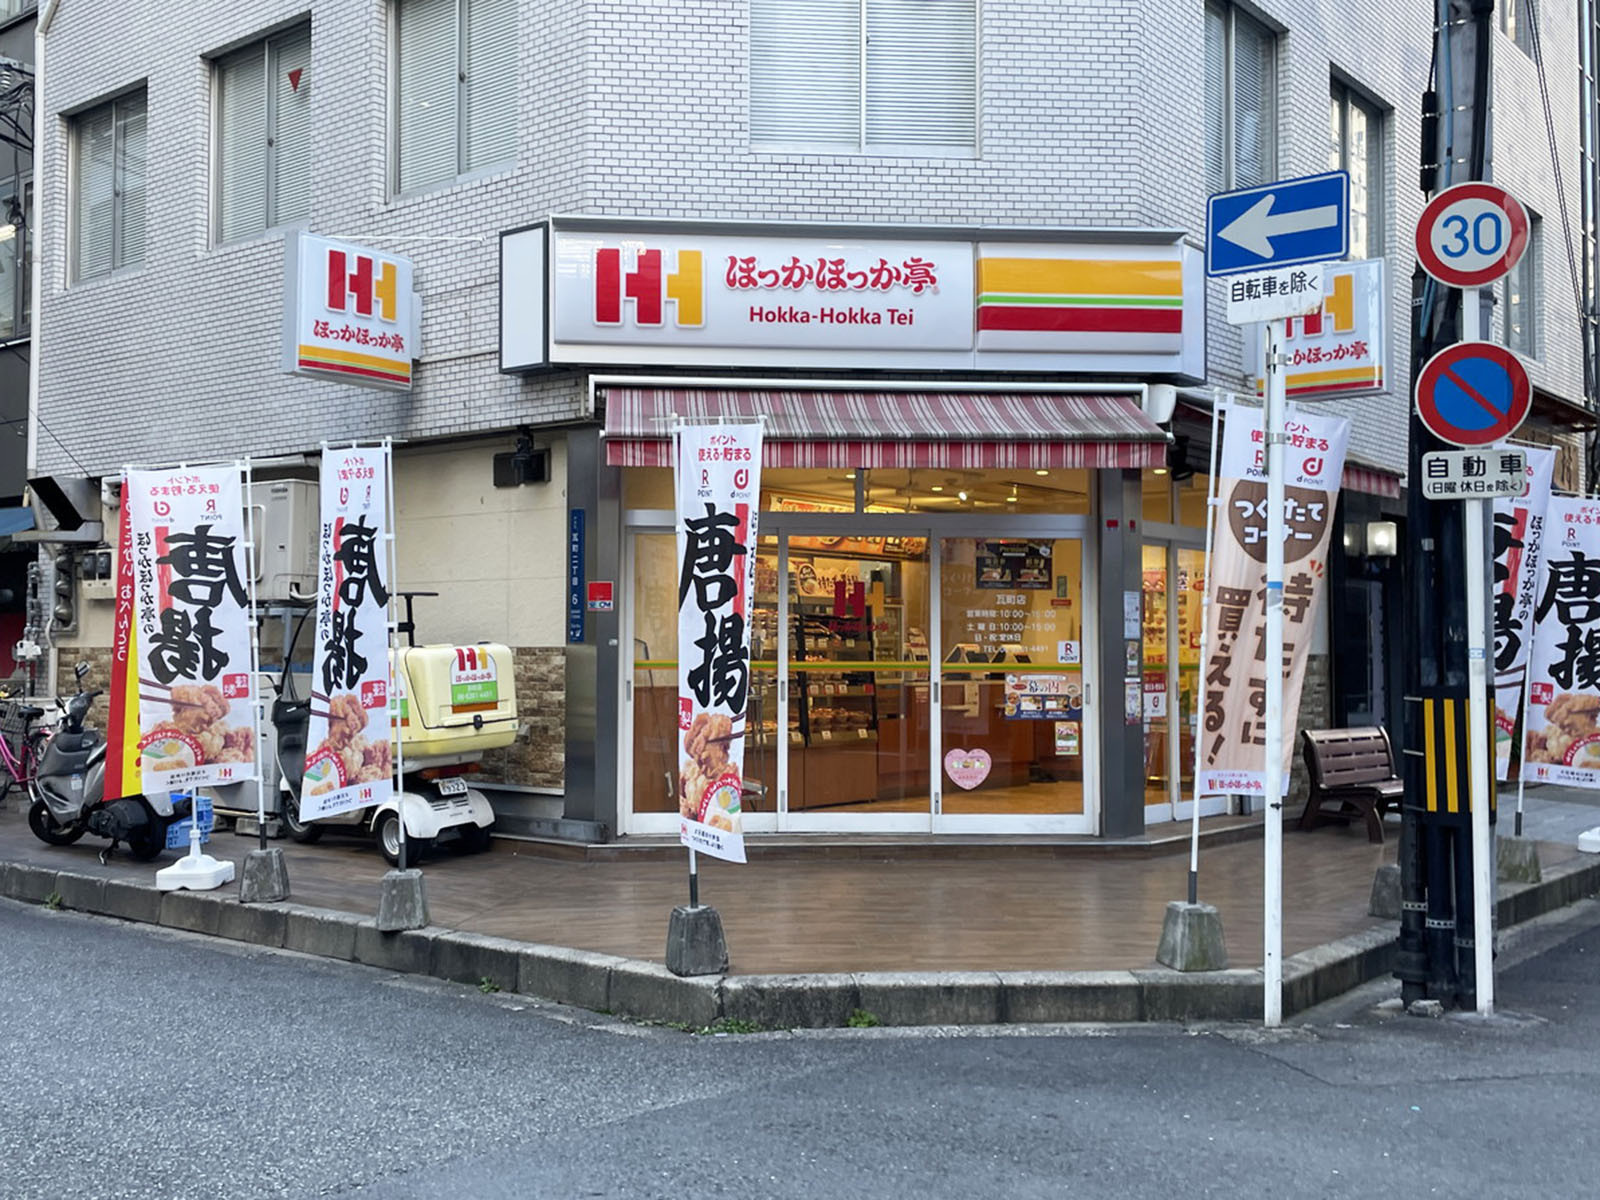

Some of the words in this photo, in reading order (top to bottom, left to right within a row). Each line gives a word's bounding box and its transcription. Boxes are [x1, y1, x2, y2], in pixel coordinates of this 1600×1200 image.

[1442, 212, 1502, 258] 30
[726, 255, 937, 293] ほっかほっか亭
[1231, 271, 1318, 302] 自転車を除く
[750, 306, 881, 325] Hokka-Hokka
[887, 308, 914, 325] Tei
[313, 320, 404, 352] ほっかほっか亭
[1292, 341, 1369, 365] かほっか亭
[710, 435, 737, 445] ポイント
[1284, 421, 1310, 434] イント
[1427, 454, 1522, 479] 自動車
[1235, 498, 1324, 521] つくたて
[1580, 506, 1600, 514] ポイン
[1518, 515, 1543, 621] ほっかほっか亭の
[679, 502, 748, 715] 唐揚
